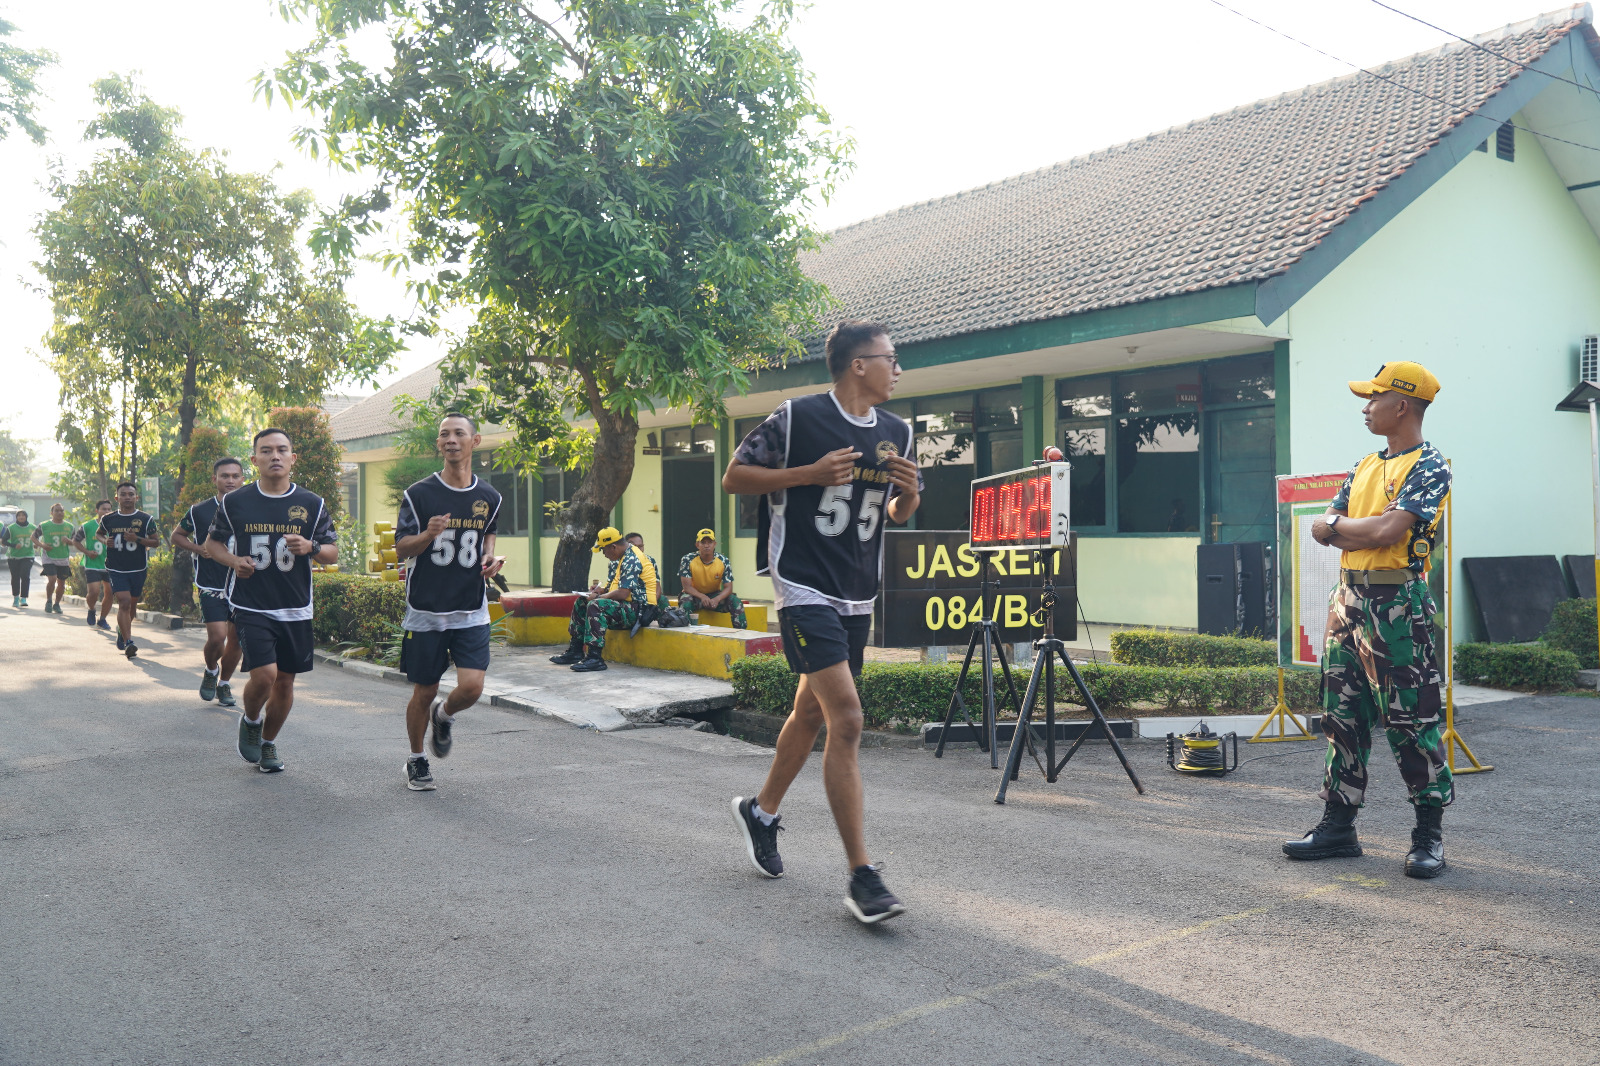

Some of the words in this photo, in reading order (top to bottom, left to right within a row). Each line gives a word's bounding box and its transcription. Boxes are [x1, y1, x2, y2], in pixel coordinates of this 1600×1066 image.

[244, 523, 274, 532] JASREM
[814, 483, 885, 542] 55
[973, 487, 995, 542] 00
[250, 535, 295, 572] 56
[431, 529, 478, 568] 58
[906, 543, 1060, 579] JASREM
